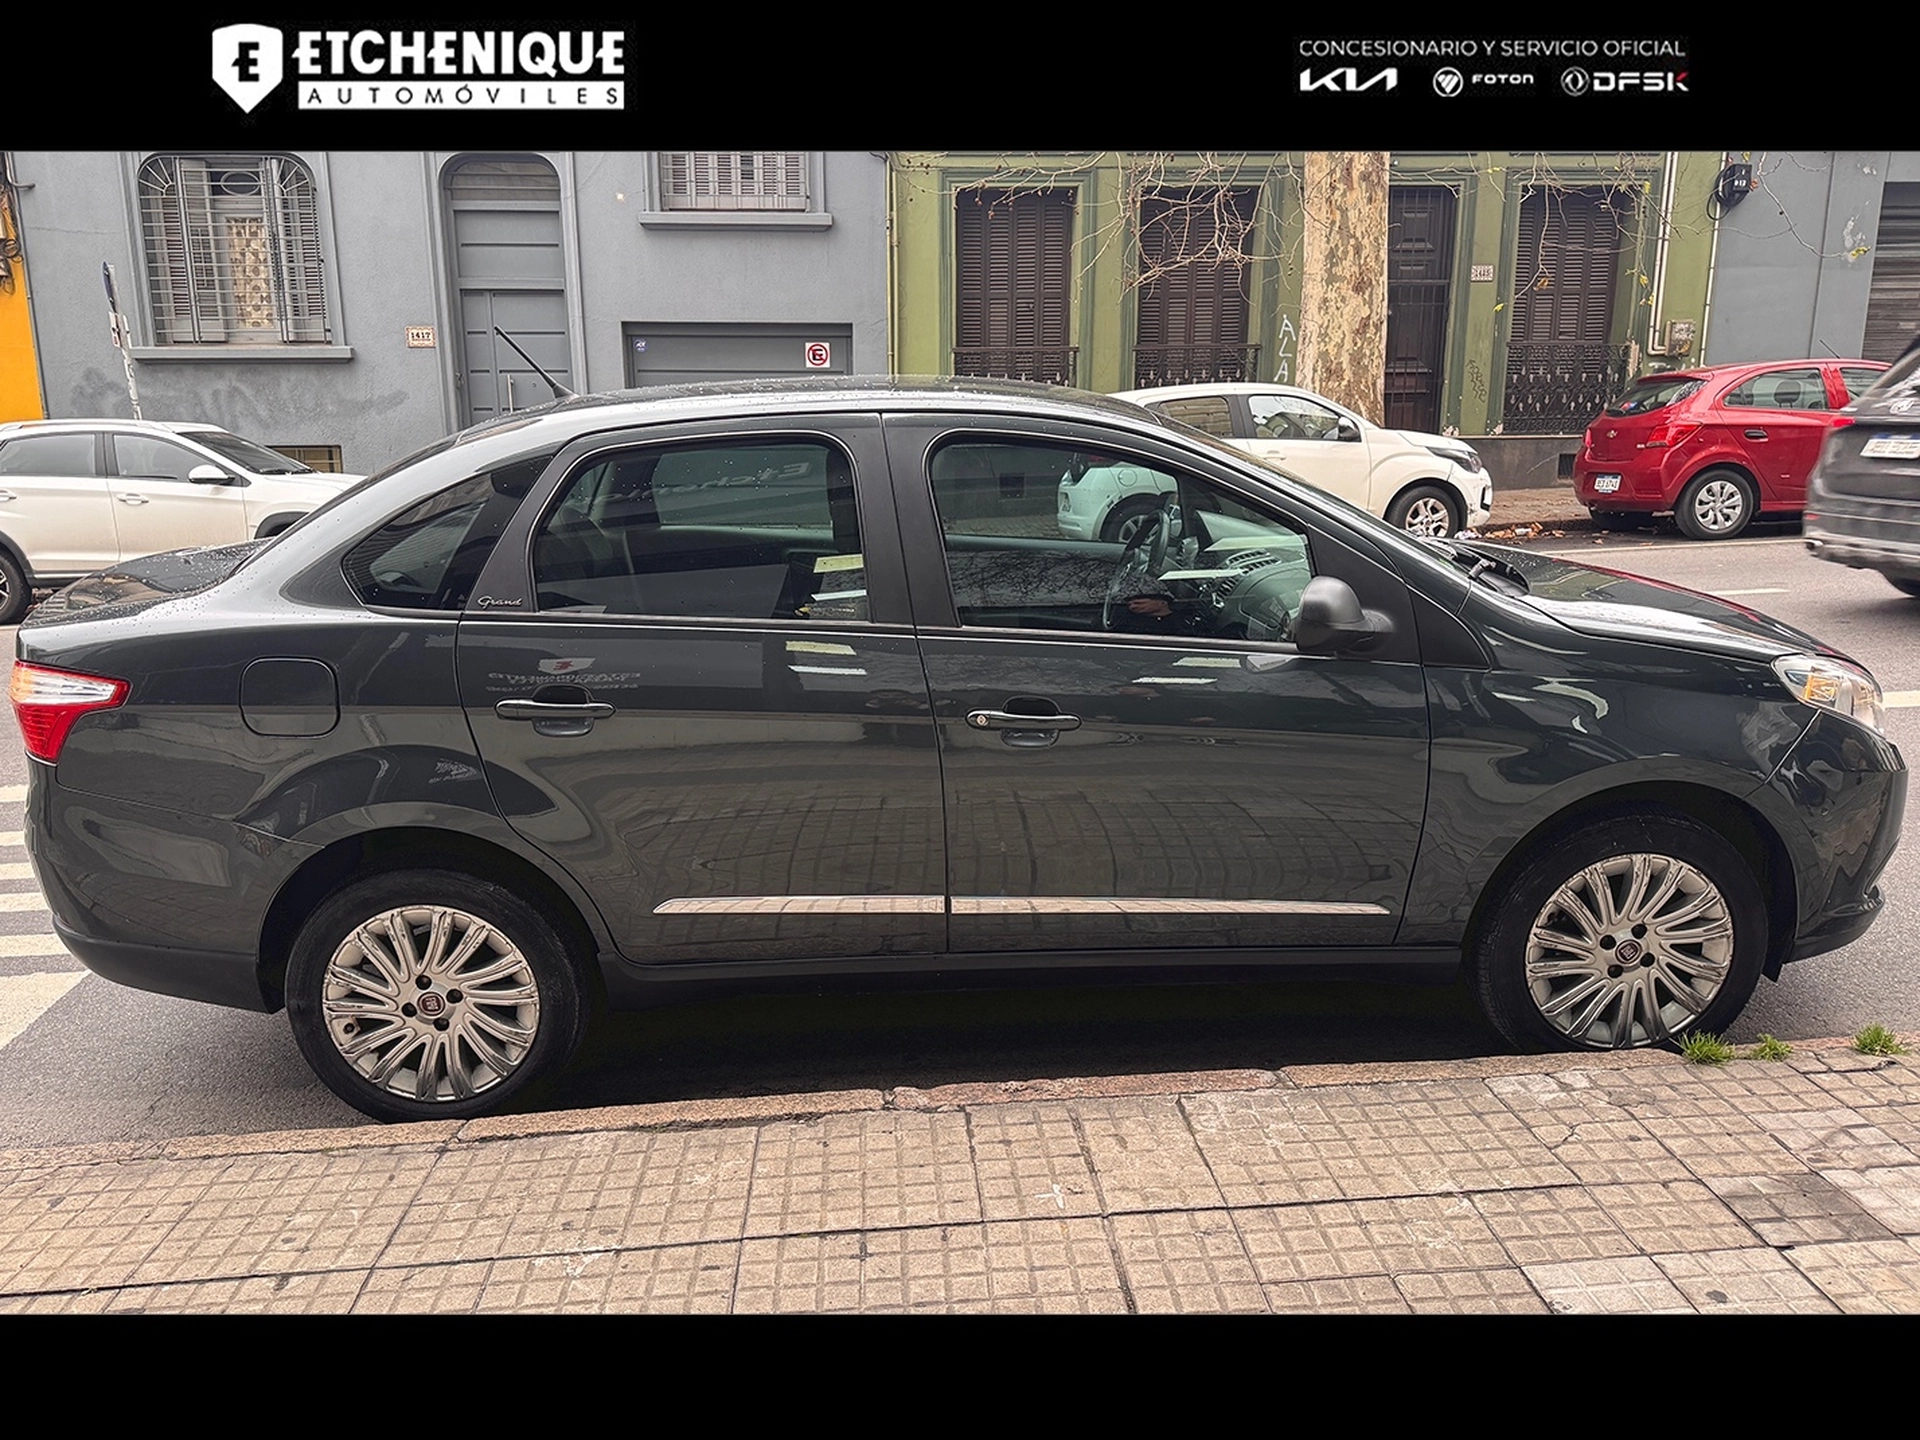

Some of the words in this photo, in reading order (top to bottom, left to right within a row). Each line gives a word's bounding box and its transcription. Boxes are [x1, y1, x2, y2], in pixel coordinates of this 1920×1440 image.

[411, 331, 431, 339] 1417
[1273, 314, 1296, 382] ALA
[477, 595, 523, 610] Grand
